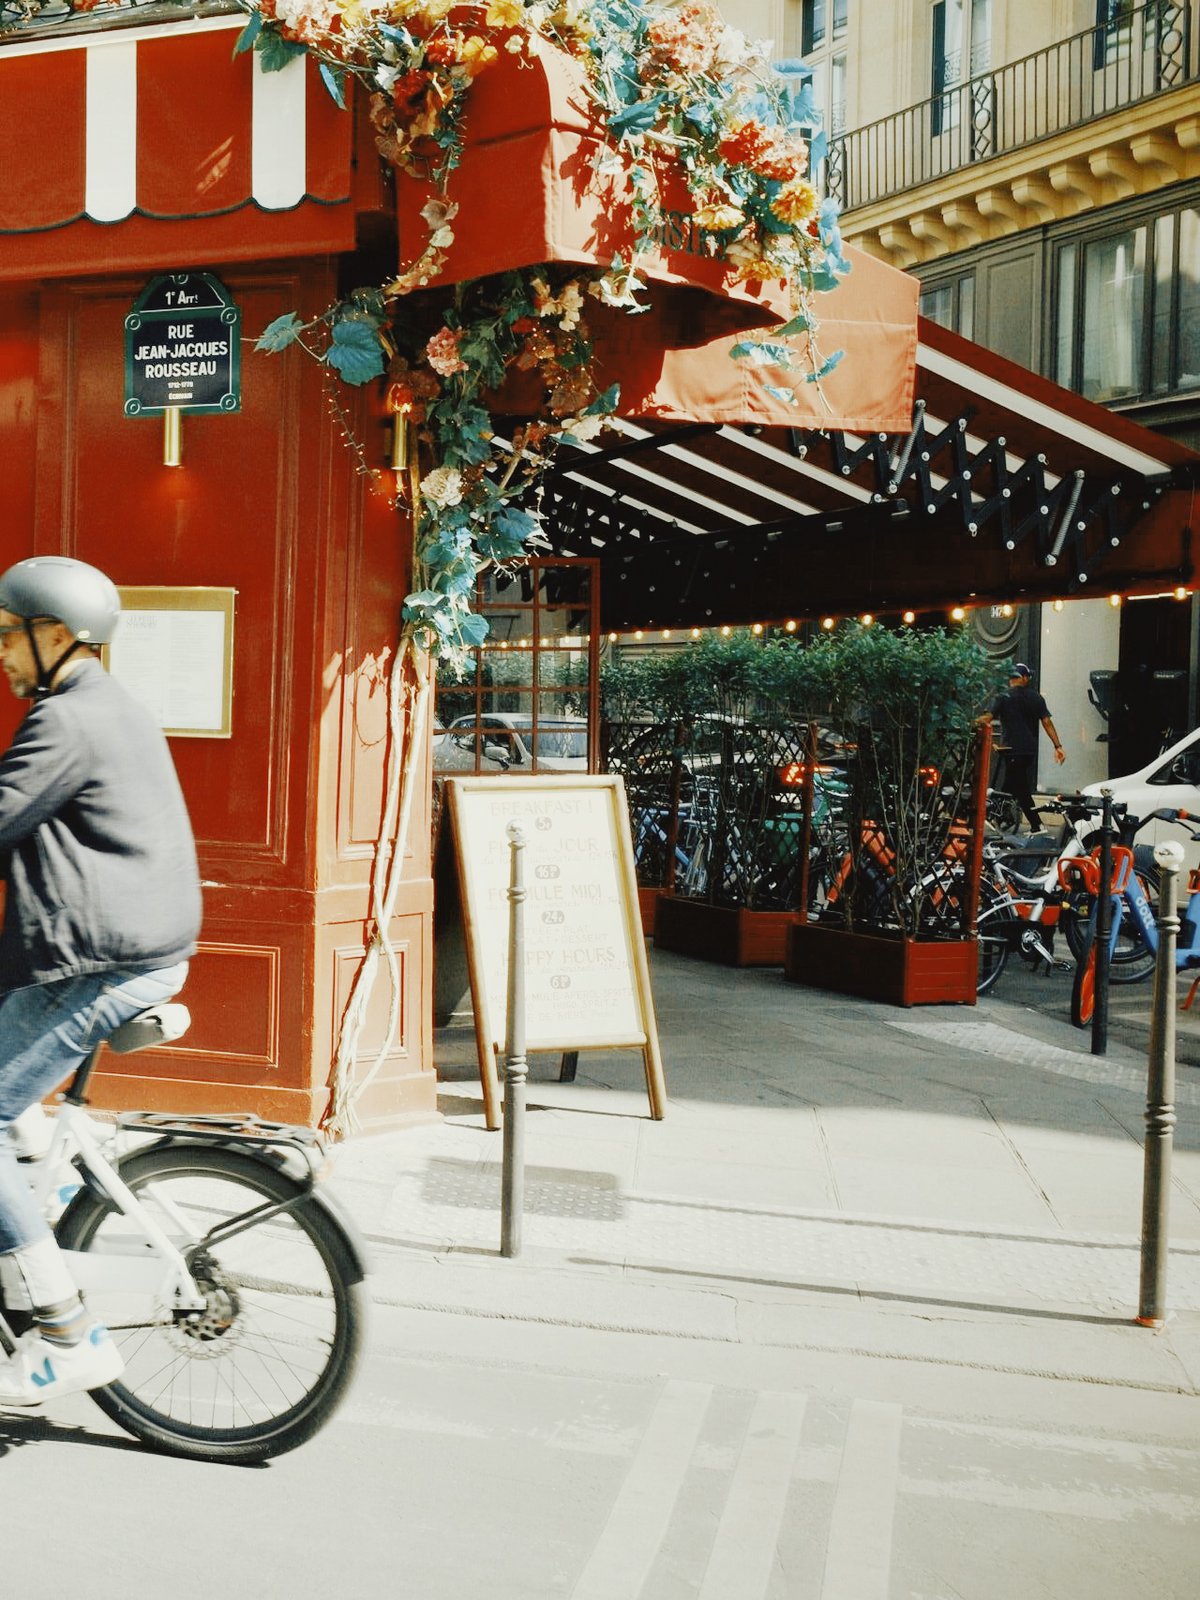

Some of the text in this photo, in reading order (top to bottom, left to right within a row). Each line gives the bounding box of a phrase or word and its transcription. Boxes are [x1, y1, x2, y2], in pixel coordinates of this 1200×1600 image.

[168, 324, 195, 339] RUE
[134, 341, 228, 360] JEAN-JACQUES
[145, 361, 217, 379] ROUSSEAU
[490, 799, 581, 817] BREAKFAST
[552, 837, 599, 853] JOUR
[571, 883, 602, 900] MIDI
[562, 947, 616, 964] HOURS
